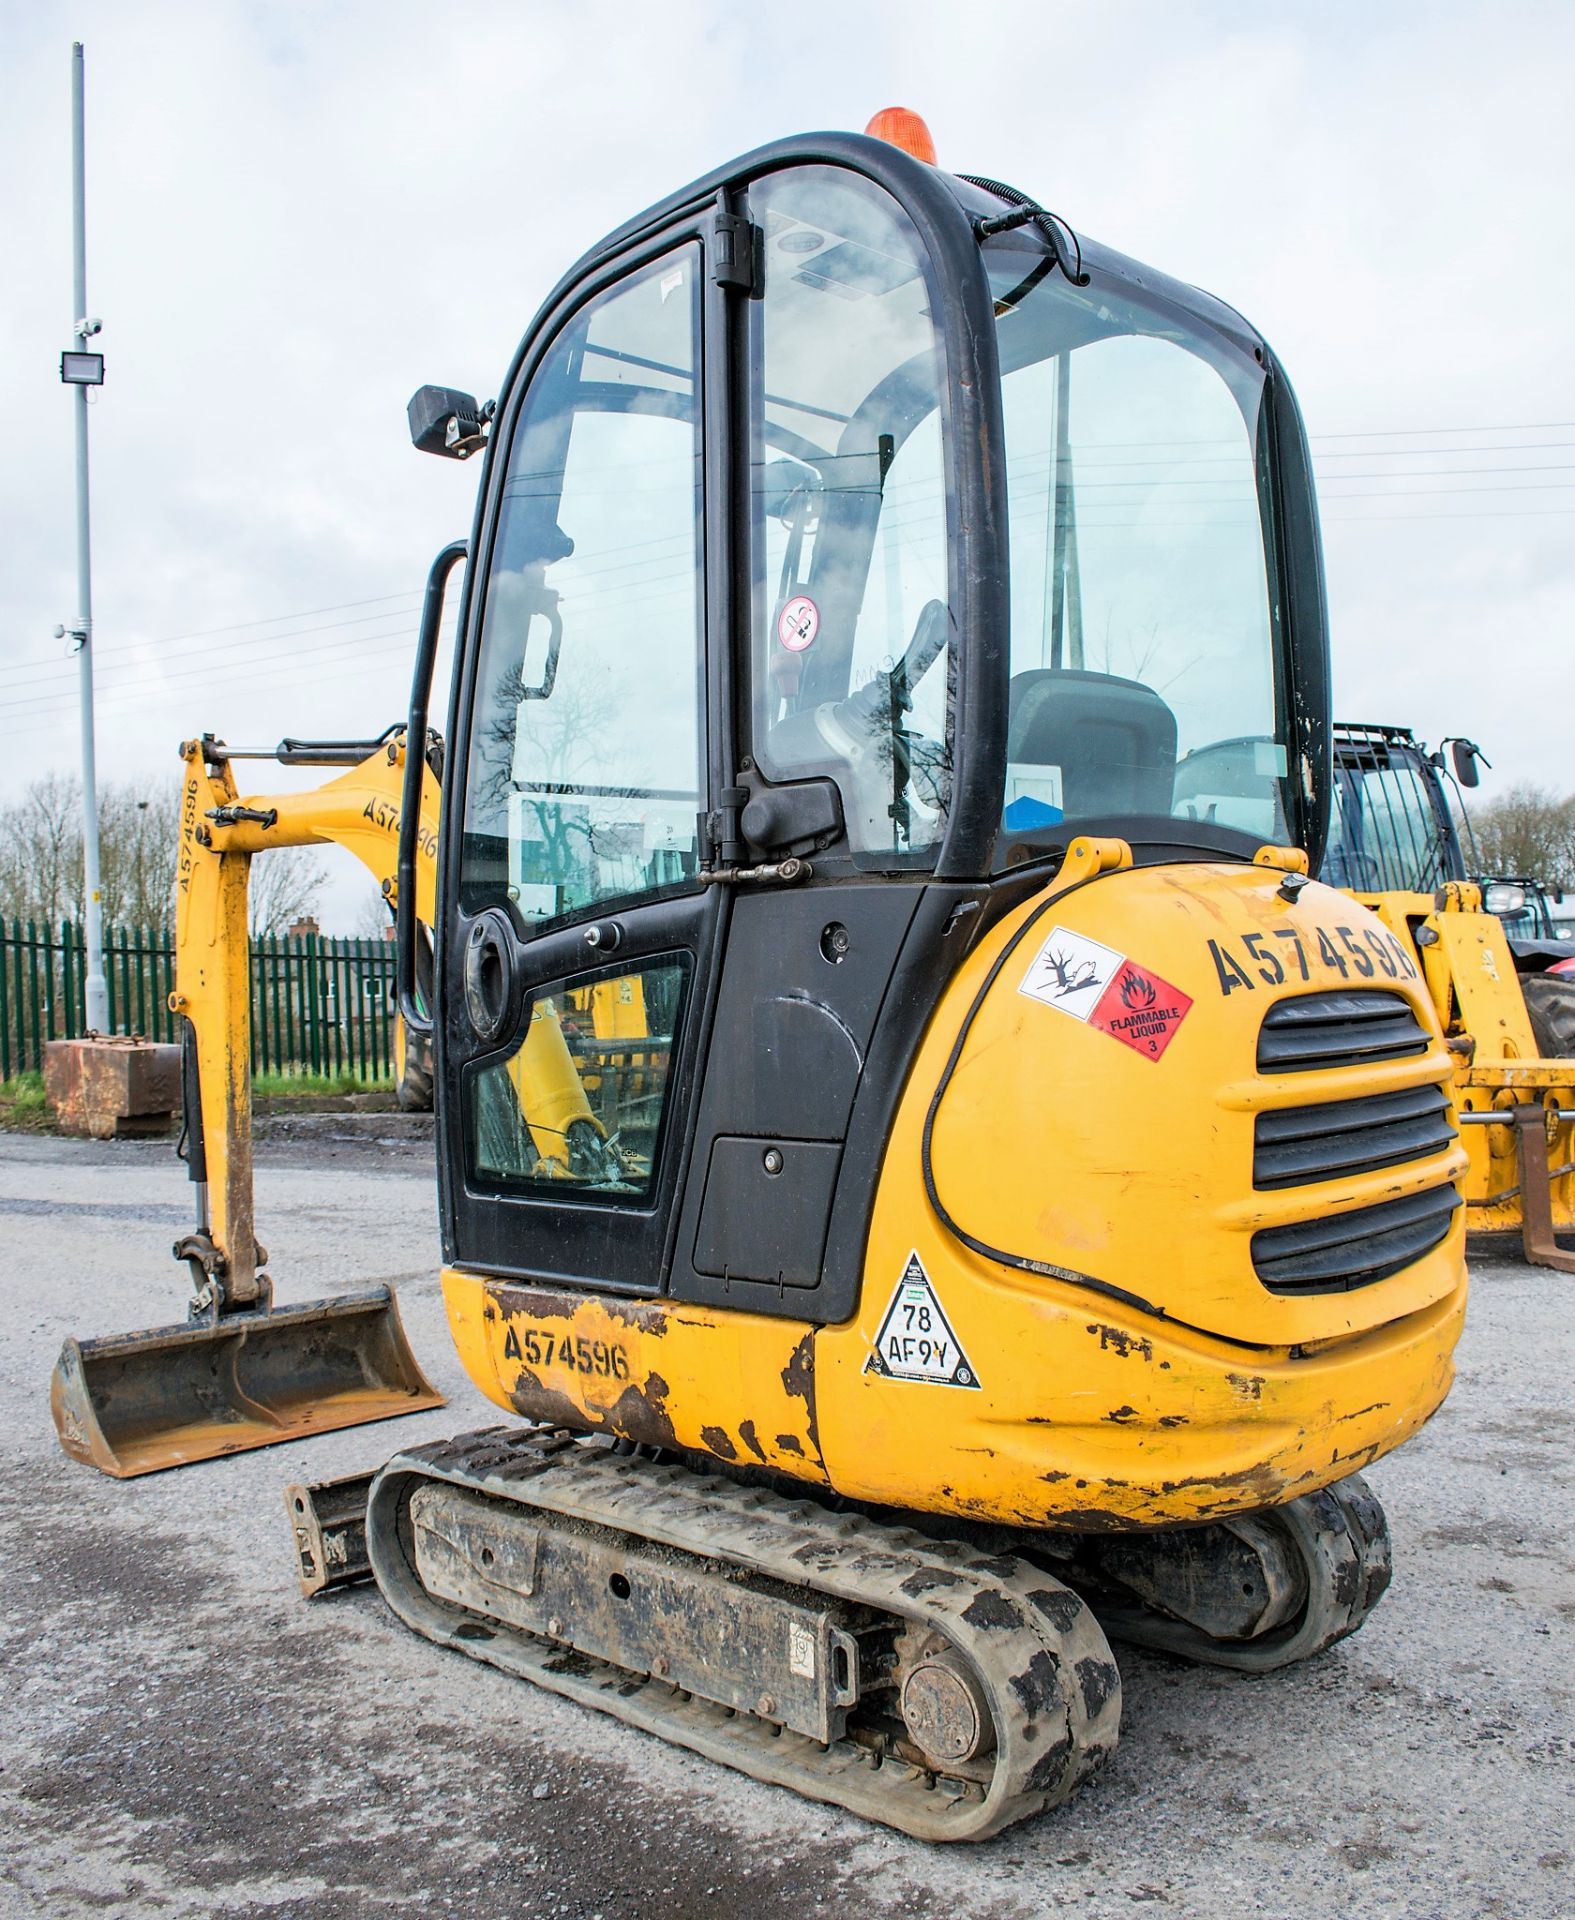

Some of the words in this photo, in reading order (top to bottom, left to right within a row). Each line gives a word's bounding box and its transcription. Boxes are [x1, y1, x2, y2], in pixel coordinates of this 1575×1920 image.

[180, 779, 198, 893] A574596
[363, 796, 439, 859] A5796
[1207, 926, 1417, 996] A574596
[1110, 1007, 1180, 1031] FLAMMABLE
[1130, 1022, 1167, 1039] LIQUID
[1148, 1040, 1158, 1052] 3
[903, 1304, 932, 1333] 78
[505, 1325, 630, 1380] A574596
[889, 1336, 947, 1368] AF9Y
